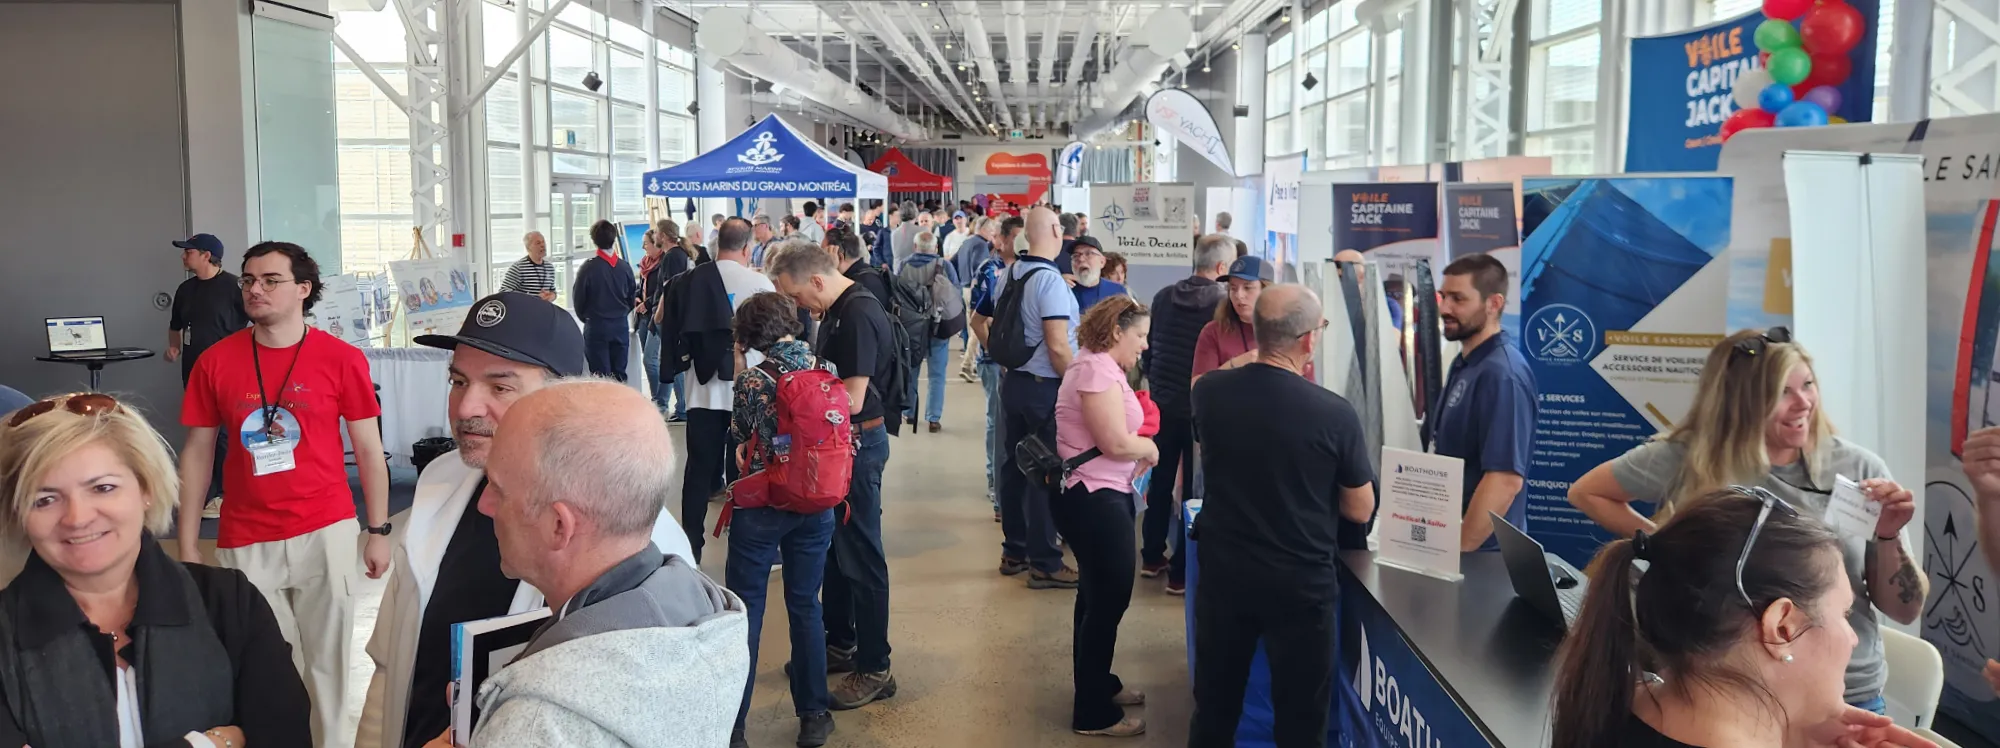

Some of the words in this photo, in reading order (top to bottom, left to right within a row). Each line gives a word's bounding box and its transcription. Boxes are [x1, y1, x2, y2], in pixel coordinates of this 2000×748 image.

[1684, 27, 1743, 67] VOILE
[1685, 93, 1734, 127] JACK
[1179, 116, 1221, 154] YACHT
[662, 181, 700, 191] SCOUTS
[702, 181, 740, 191] MARINS
[742, 181, 757, 191] DU
[758, 181, 797, 191] GRAND
[798, 180, 852, 191] MONTRÉAL
[1351, 192, 1389, 203] VOILE
[1350, 203, 1414, 214] CAPITAINE
[1458, 207, 1500, 218] CAPITAINE
[1350, 214, 1383, 224] JACK
[1458, 219, 1481, 230] JACK
[1117, 236, 1146, 247] Voile
[1148, 237, 1188, 248] Océan
[1536, 328, 1548, 341] V
[1572, 329, 1584, 343] S
[1613, 334, 1649, 344] VOILE
[1612, 354, 1649, 363] SERVICE
[1651, 355, 1662, 363] DE
[1602, 363, 1663, 373] ACCESSOIRES
[1546, 394, 1585, 403] SERVICES
[1405, 465, 1449, 478] BOATHOUSE
[1392, 512, 1421, 523] Practical
[1427, 519, 1447, 528] Sailor
